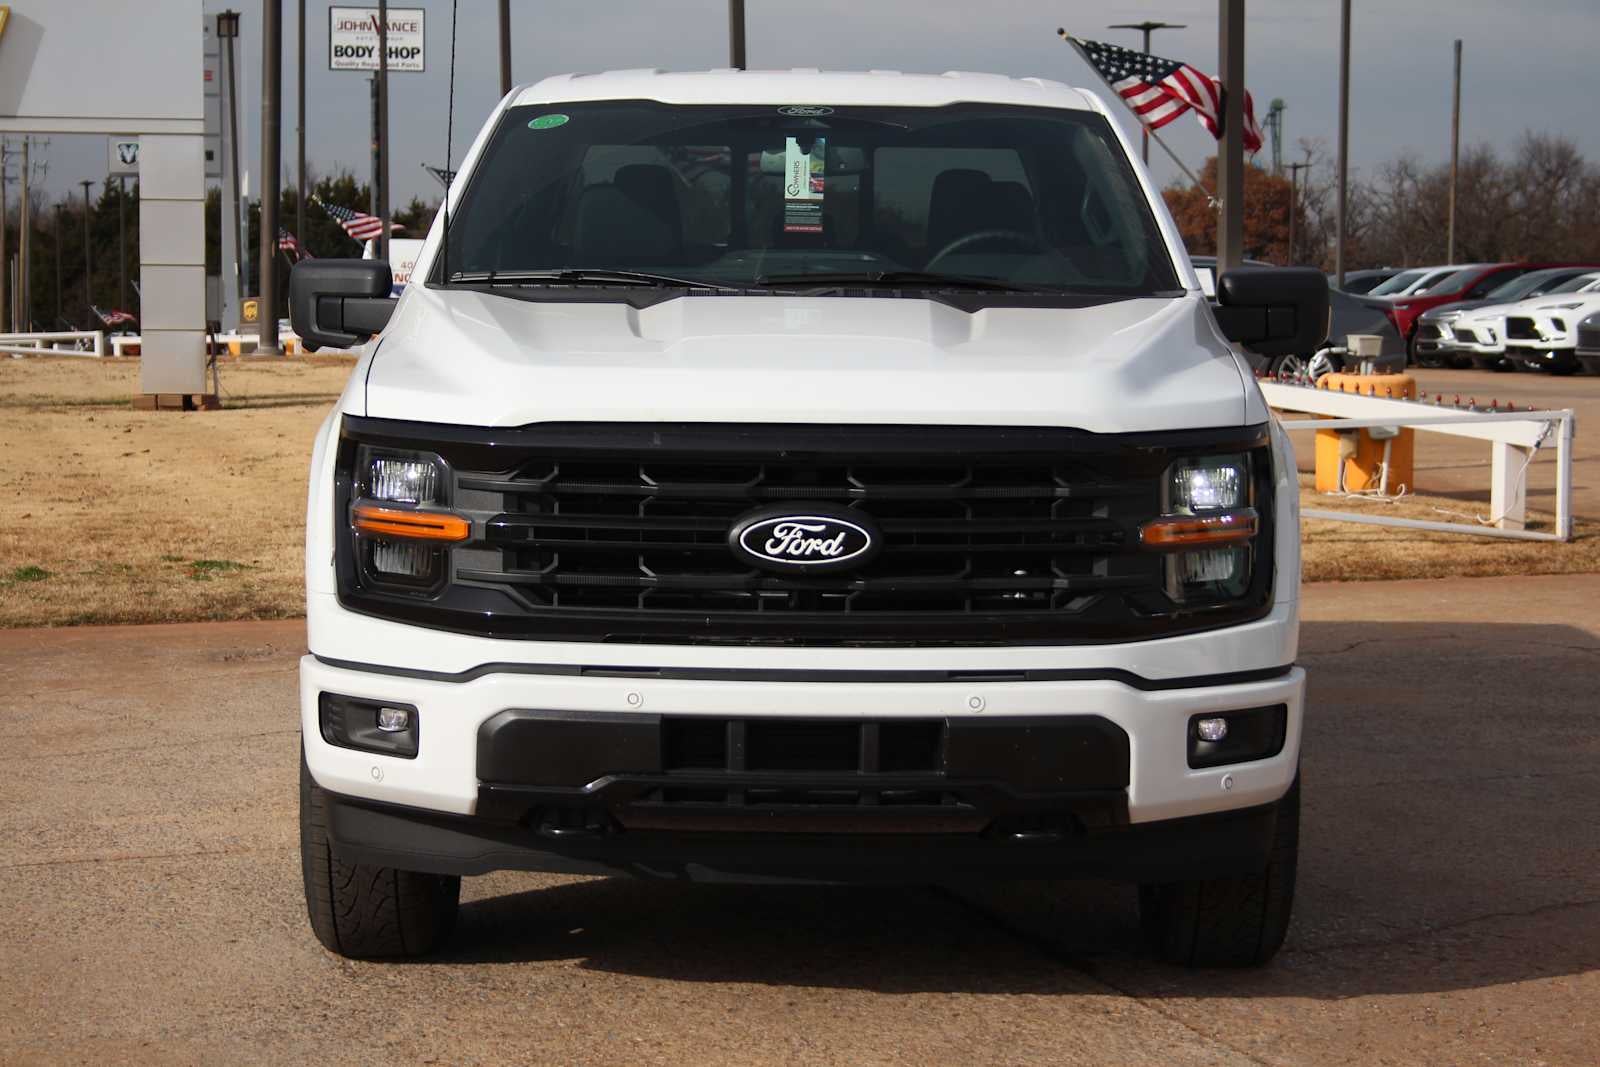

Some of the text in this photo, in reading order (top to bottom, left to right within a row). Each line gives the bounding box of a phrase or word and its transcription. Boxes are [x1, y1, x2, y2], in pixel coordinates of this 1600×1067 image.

[337, 20, 372, 31] JOHN
[334, 45, 421, 59] BODY HOP
[765, 523, 846, 556] Ford
